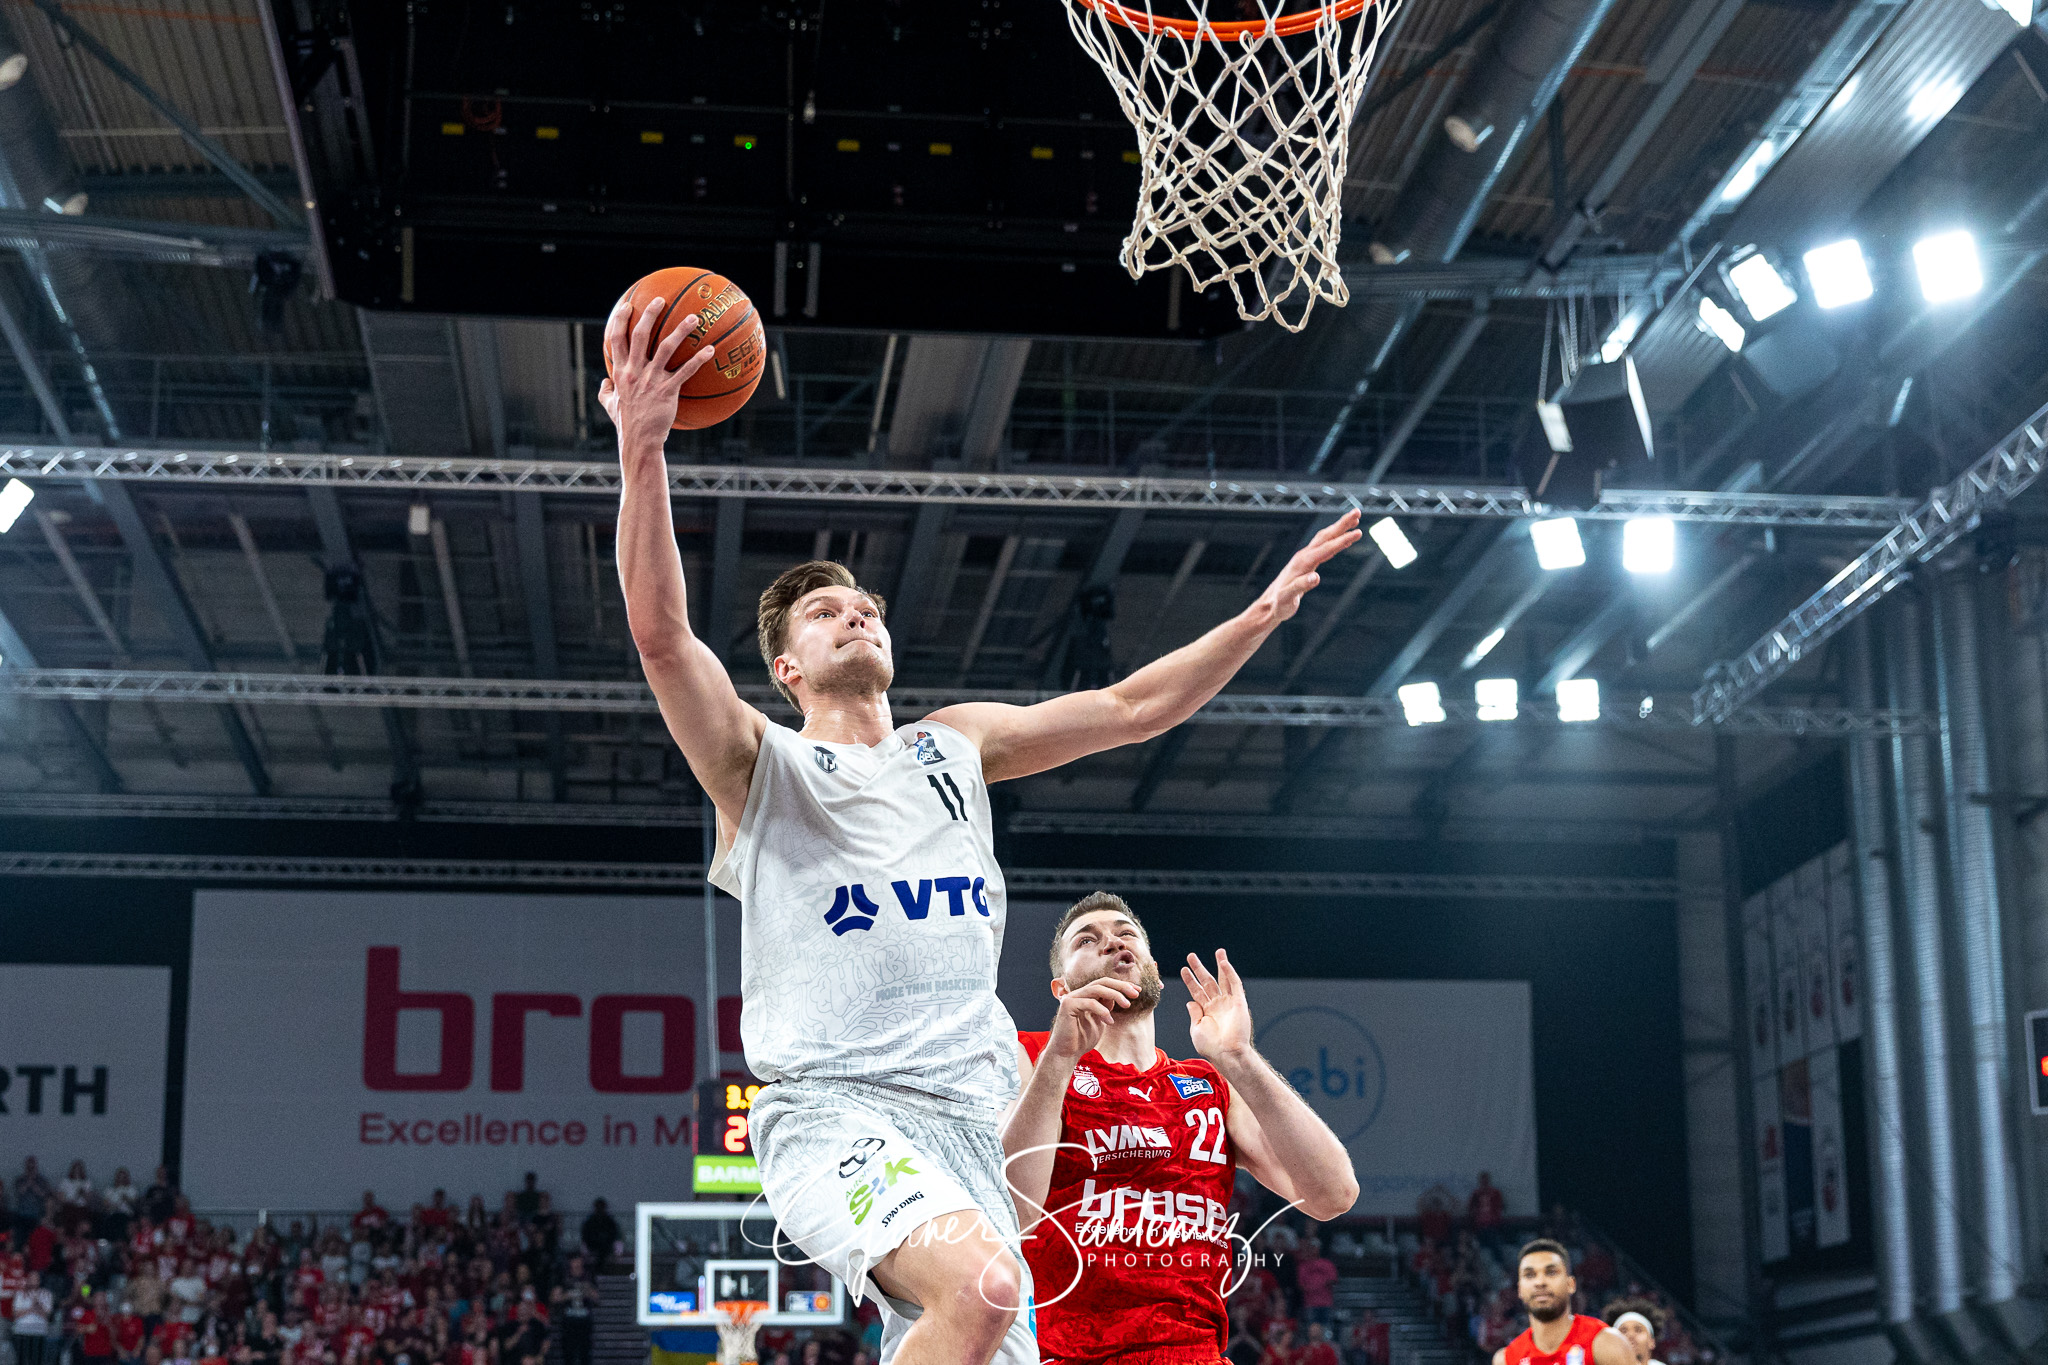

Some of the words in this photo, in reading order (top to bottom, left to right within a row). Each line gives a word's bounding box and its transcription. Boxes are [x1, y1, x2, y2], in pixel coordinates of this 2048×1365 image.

[927, 773, 968, 821] 11
[875, 988, 905, 1002] MORE
[906, 981, 933, 996] THAN
[363, 946, 743, 1093] bro
[1183, 1084, 1209, 1096] BBL
[359, 1112, 588, 1147] Excellence
[604, 1113, 637, 1146] in
[655, 1115, 694, 1146] M
[724, 1115, 749, 1153] 2
[1184, 1107, 1228, 1165] 22
[697, 1164, 760, 1184] BARM
[1077, 1178, 1228, 1233] brose
